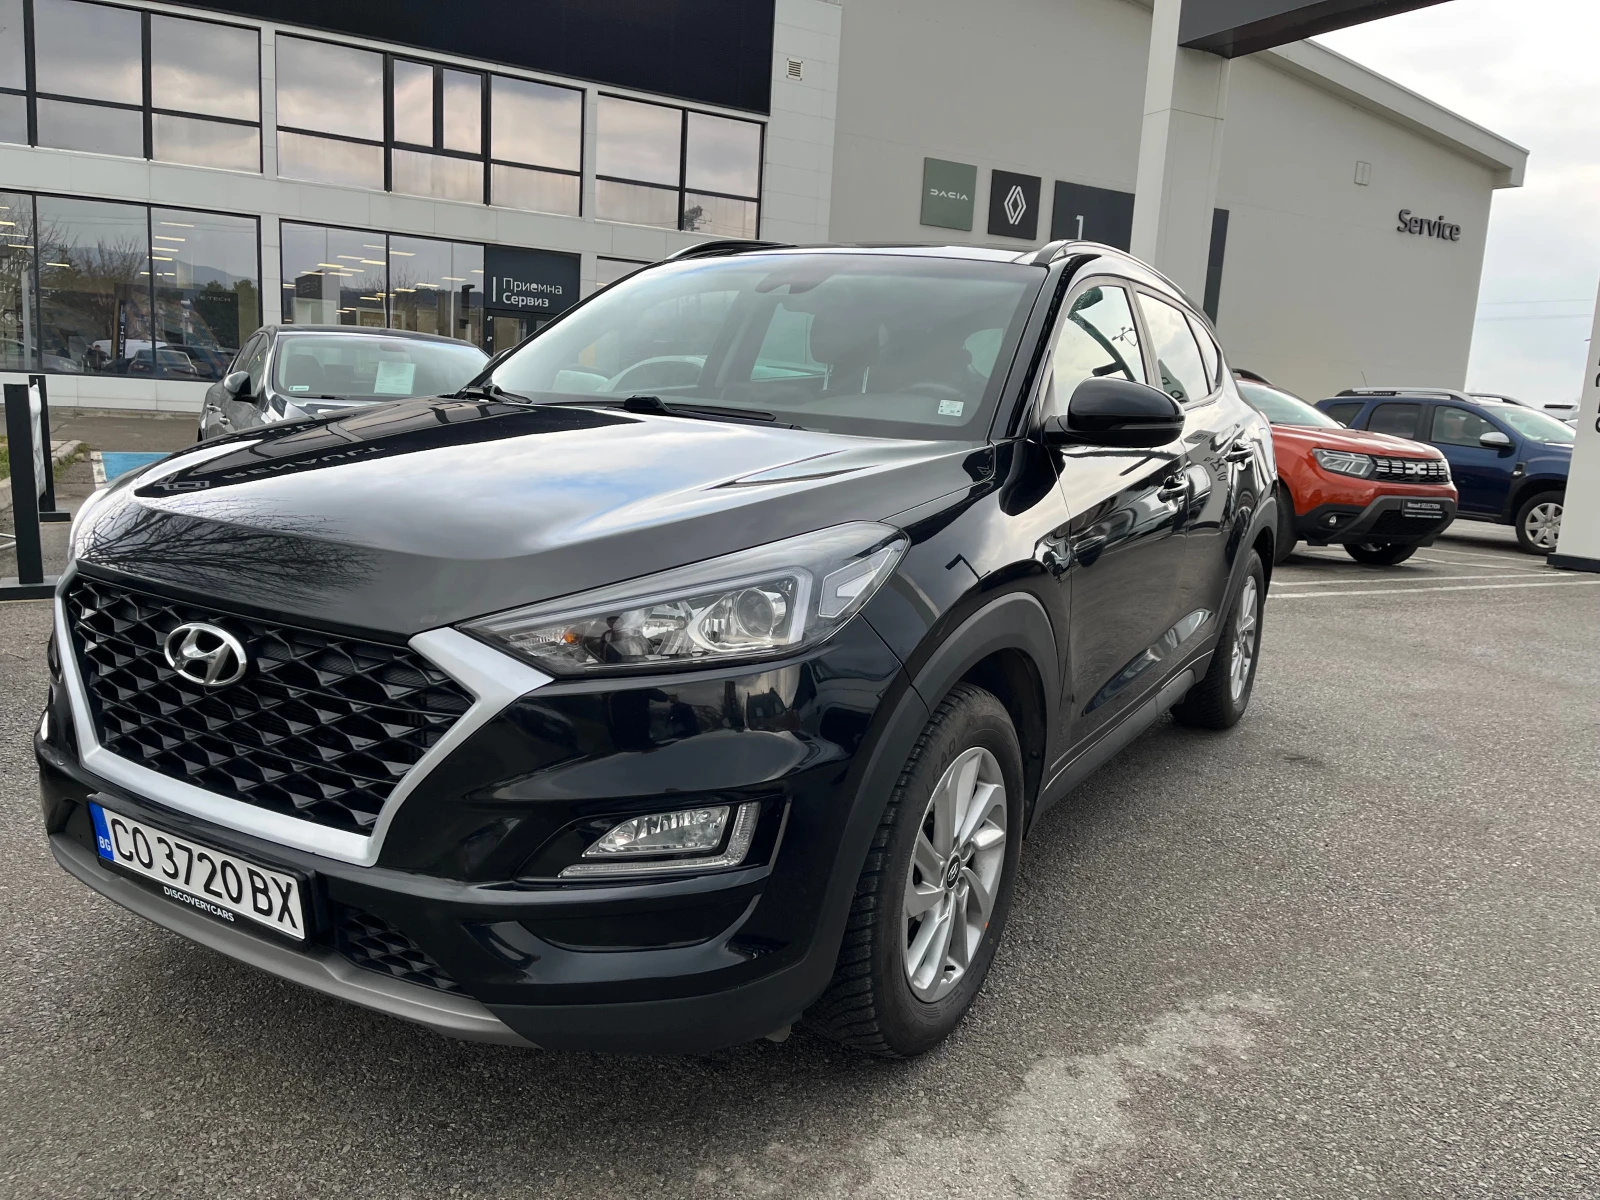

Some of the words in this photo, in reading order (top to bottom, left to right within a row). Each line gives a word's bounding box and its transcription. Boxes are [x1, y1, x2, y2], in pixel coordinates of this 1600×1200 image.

[930, 188, 968, 201] DACIA
[1396, 208, 1461, 242] Service
[503, 277, 563, 295] Приемна
[502, 292, 549, 308] Сервиз
[99, 835, 111, 852] BG
[110, 817, 154, 870] CO
[156, 836, 243, 905] 3720
[246, 866, 298, 930] BX
[163, 886, 235, 923] DISCOVERYCARS
